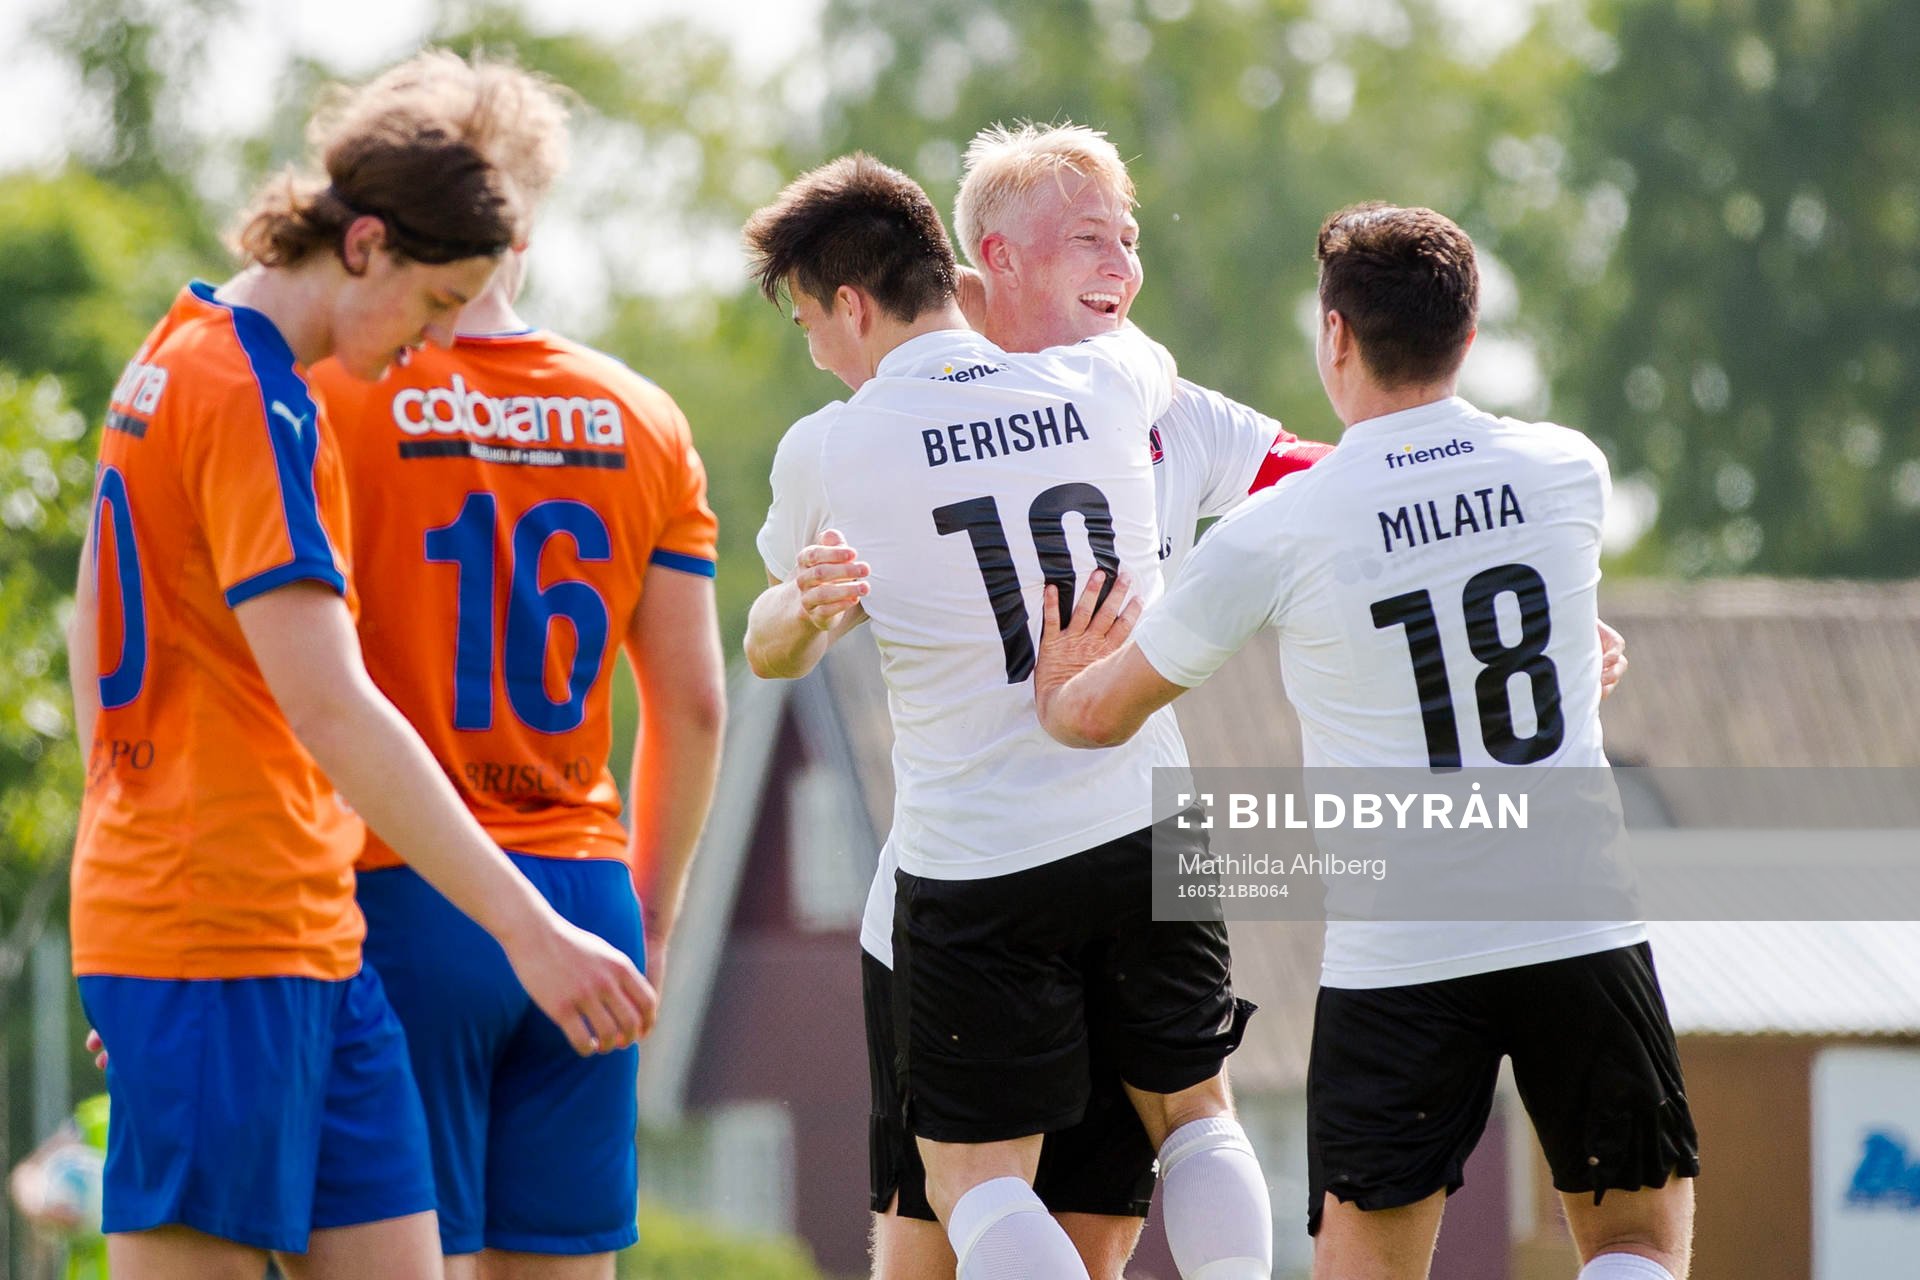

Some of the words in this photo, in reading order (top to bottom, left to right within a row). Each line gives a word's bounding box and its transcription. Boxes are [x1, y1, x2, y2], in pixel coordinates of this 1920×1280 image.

[392, 373, 625, 446] colorama
[922, 402, 1090, 467] BERISHA
[1385, 439, 1475, 469] friends
[1377, 484, 1526, 553] MILATA
[425, 491, 613, 735] 16
[932, 482, 1120, 684] 10
[1370, 563, 1565, 775] 18
